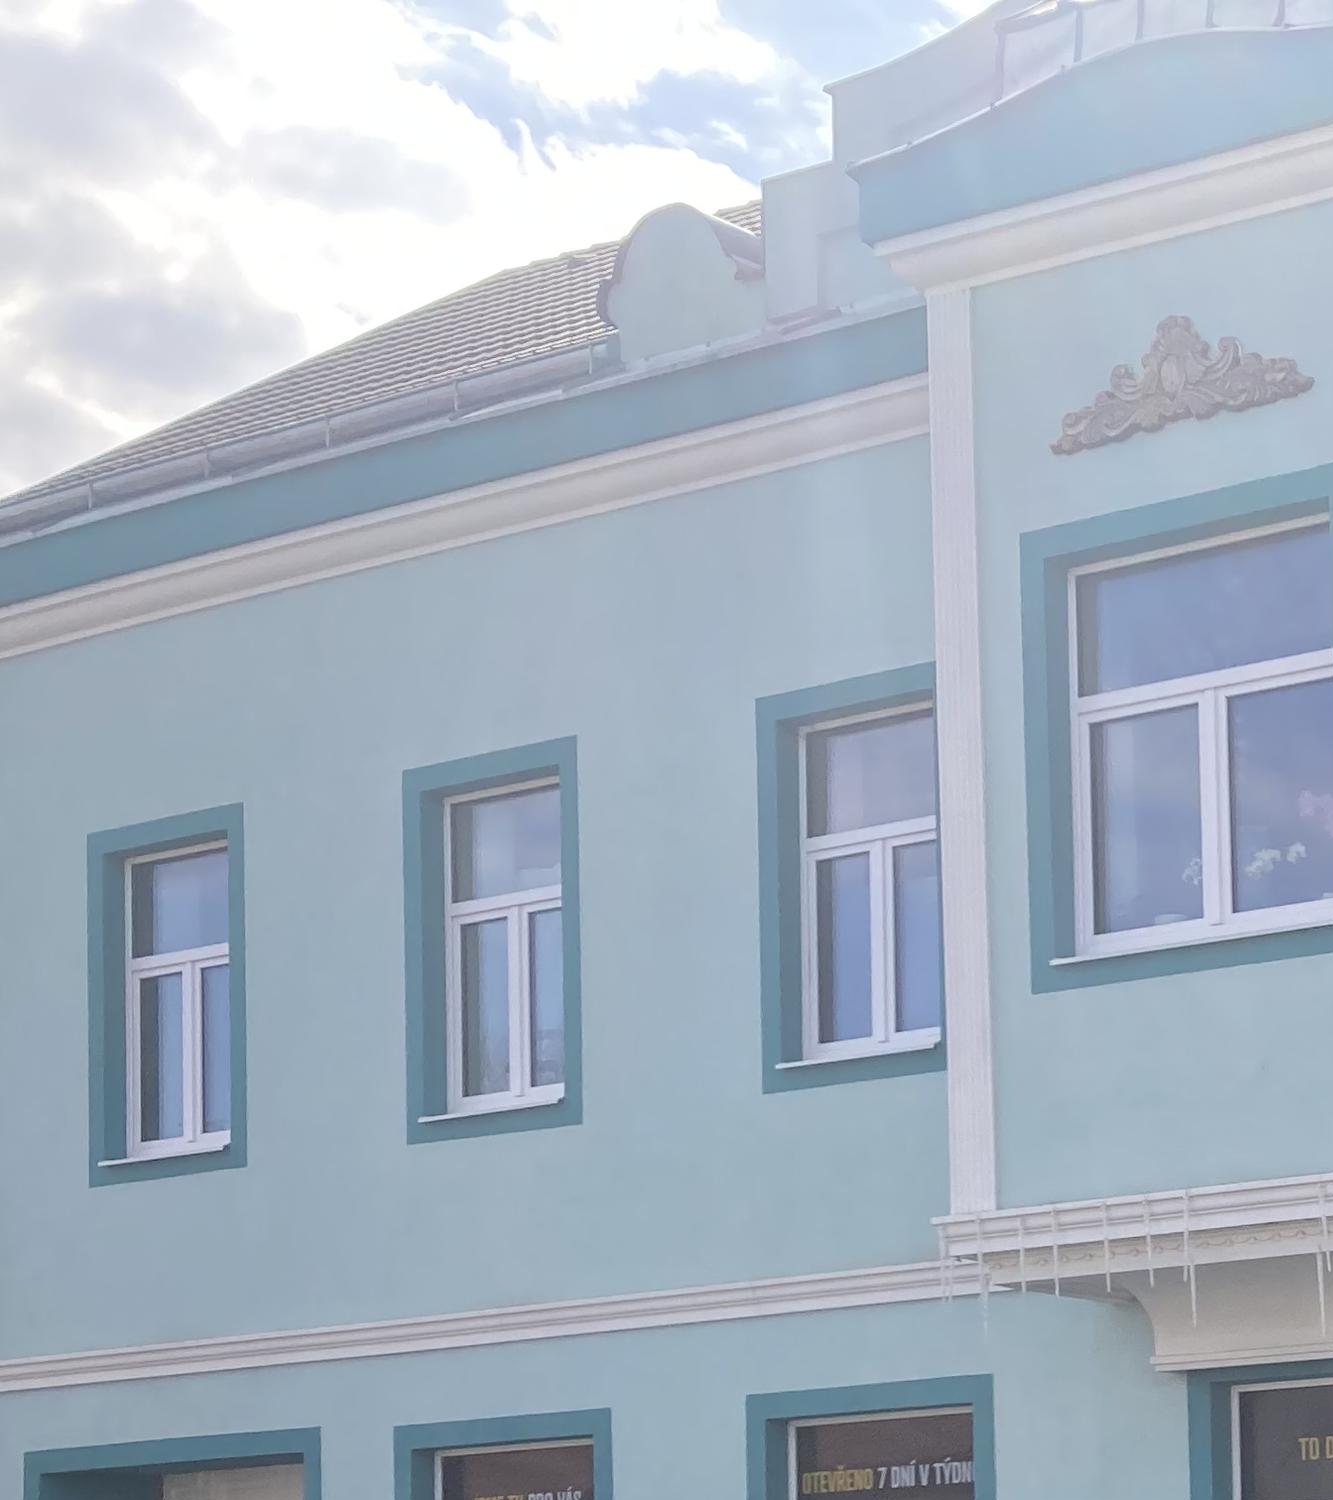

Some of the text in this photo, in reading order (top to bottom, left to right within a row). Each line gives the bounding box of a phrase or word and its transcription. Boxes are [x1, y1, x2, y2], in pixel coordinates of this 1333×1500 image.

[1299, 1437, 1320, 1461] TO
[802, 1464, 874, 1494] OTEVŘENO
[877, 1466, 888, 1489] 7
[891, 1460, 917, 1488] DNÍ
[919, 1463, 930, 1486] V
